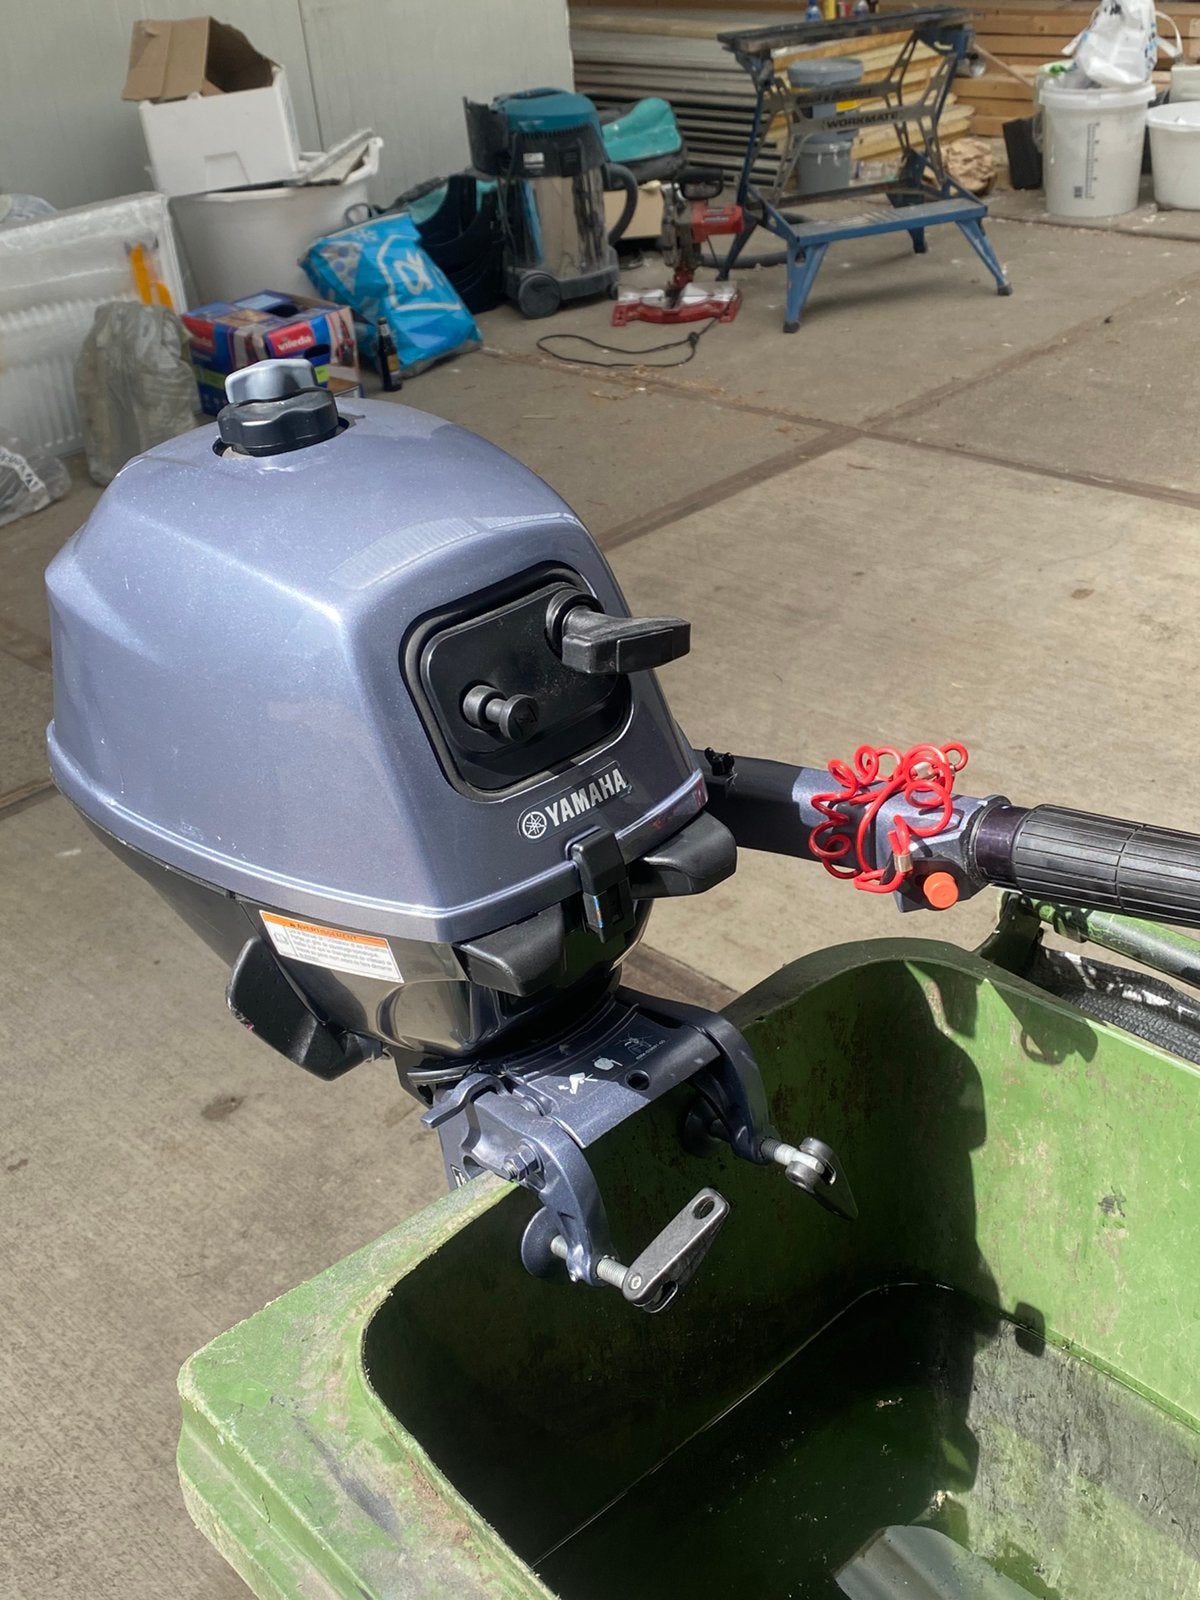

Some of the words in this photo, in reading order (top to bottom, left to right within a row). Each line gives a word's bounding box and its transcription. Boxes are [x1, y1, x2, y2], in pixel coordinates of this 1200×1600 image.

[828, 111, 898, 129] WORKMATE
[277, 335, 313, 351] vileda
[545, 768, 628, 827] YAMAHA
